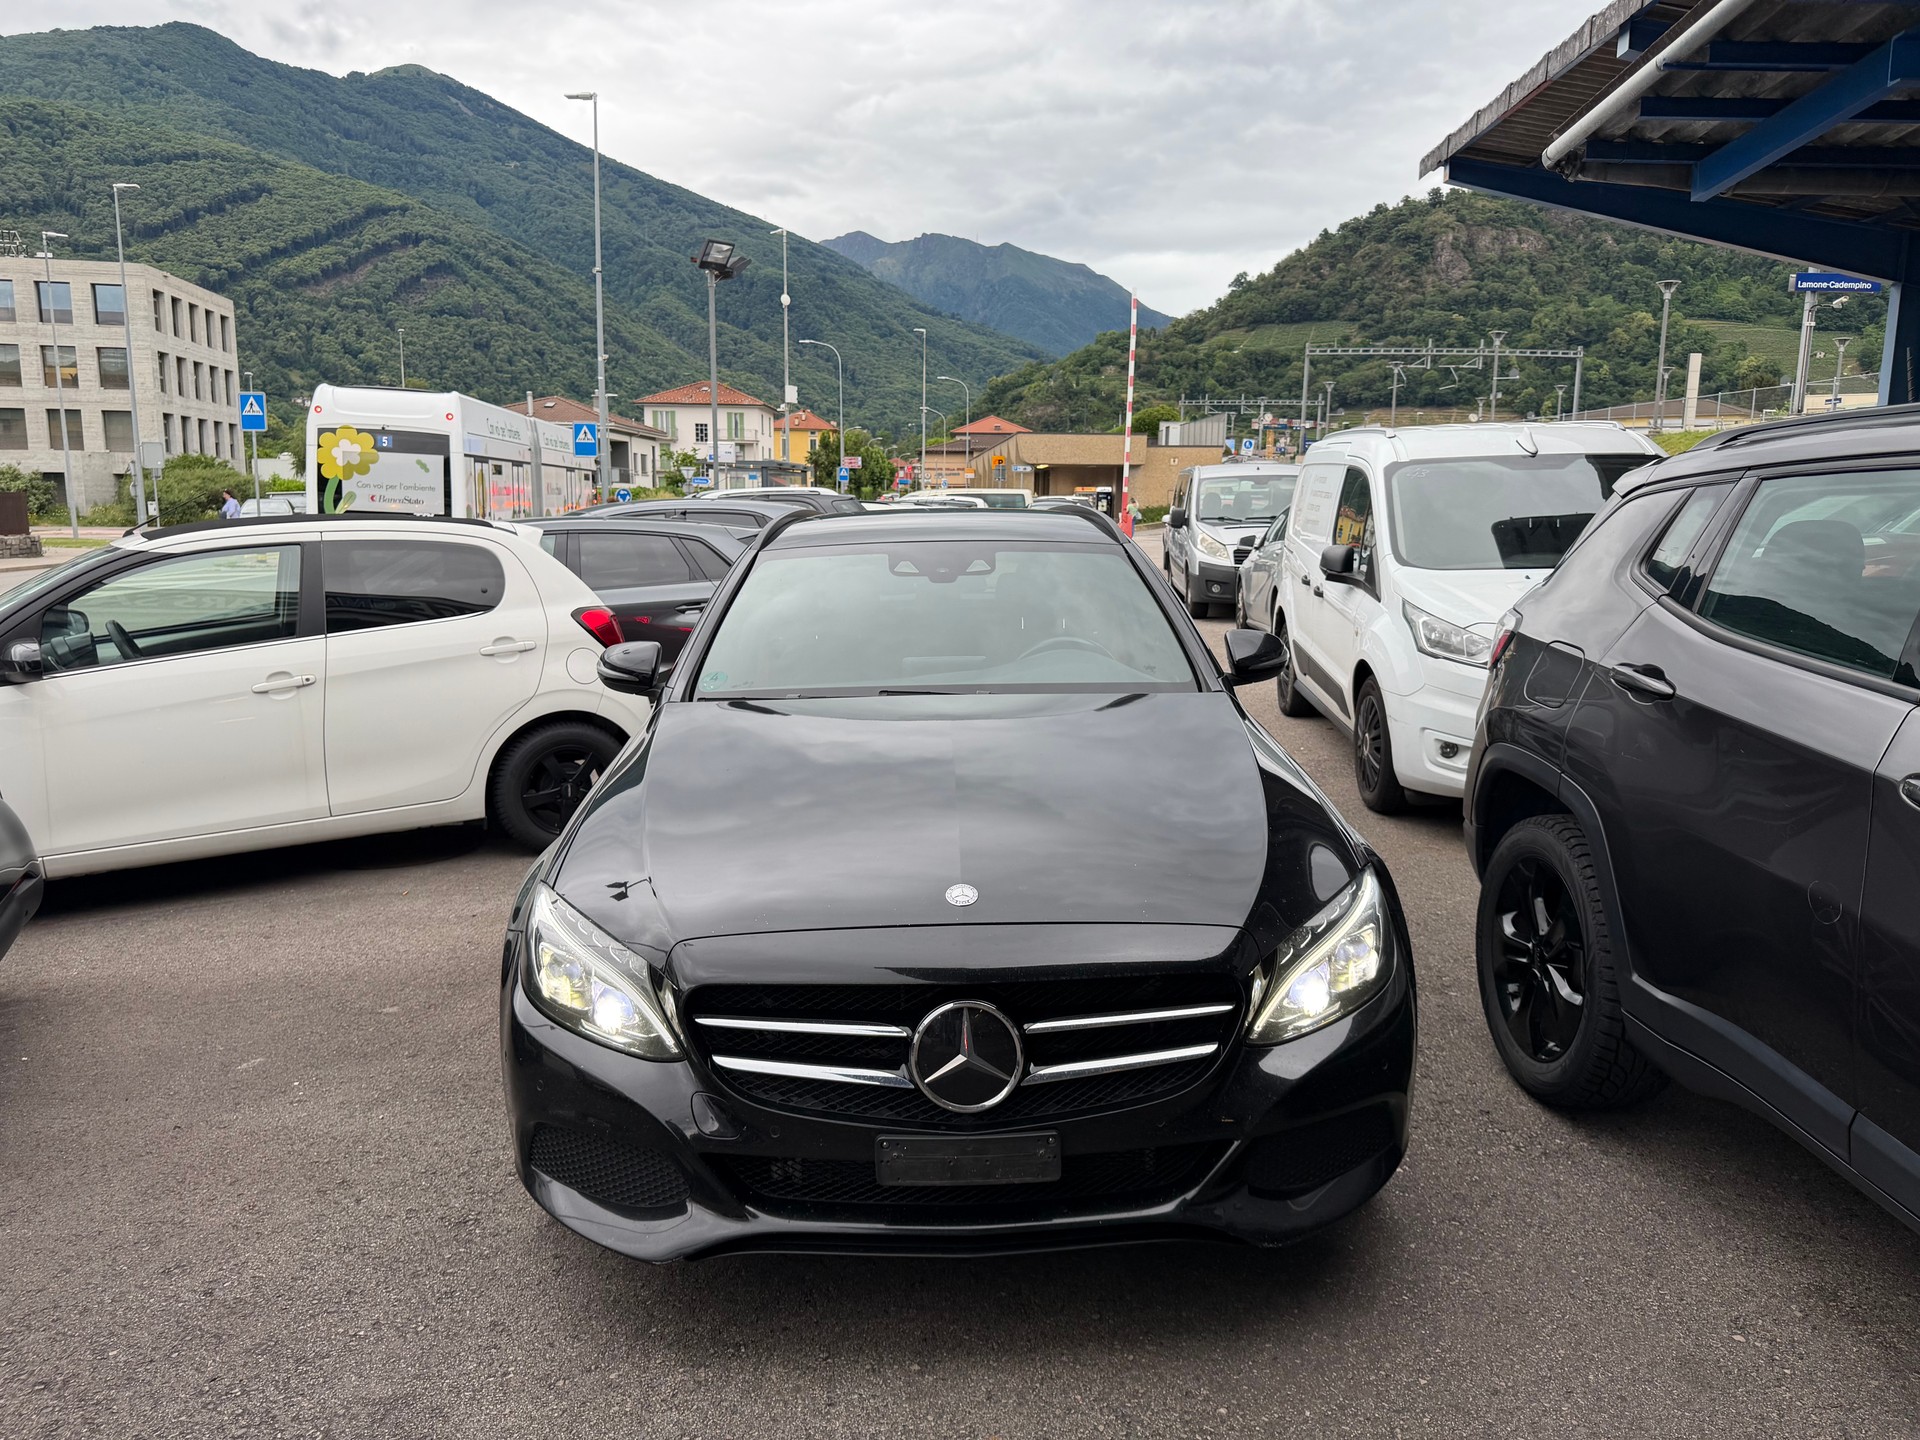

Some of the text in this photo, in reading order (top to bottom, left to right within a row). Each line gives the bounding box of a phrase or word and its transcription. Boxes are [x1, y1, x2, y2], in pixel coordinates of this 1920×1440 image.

[1797, 280, 1872, 290] Lamone-Cadempino
[382, 436, 388, 447] 5
[356, 480, 371, 489] Con
[385, 484, 397, 492] per
[399, 482, 436, 492] l'ambiente
[378, 494, 425, 505] BancaStato
